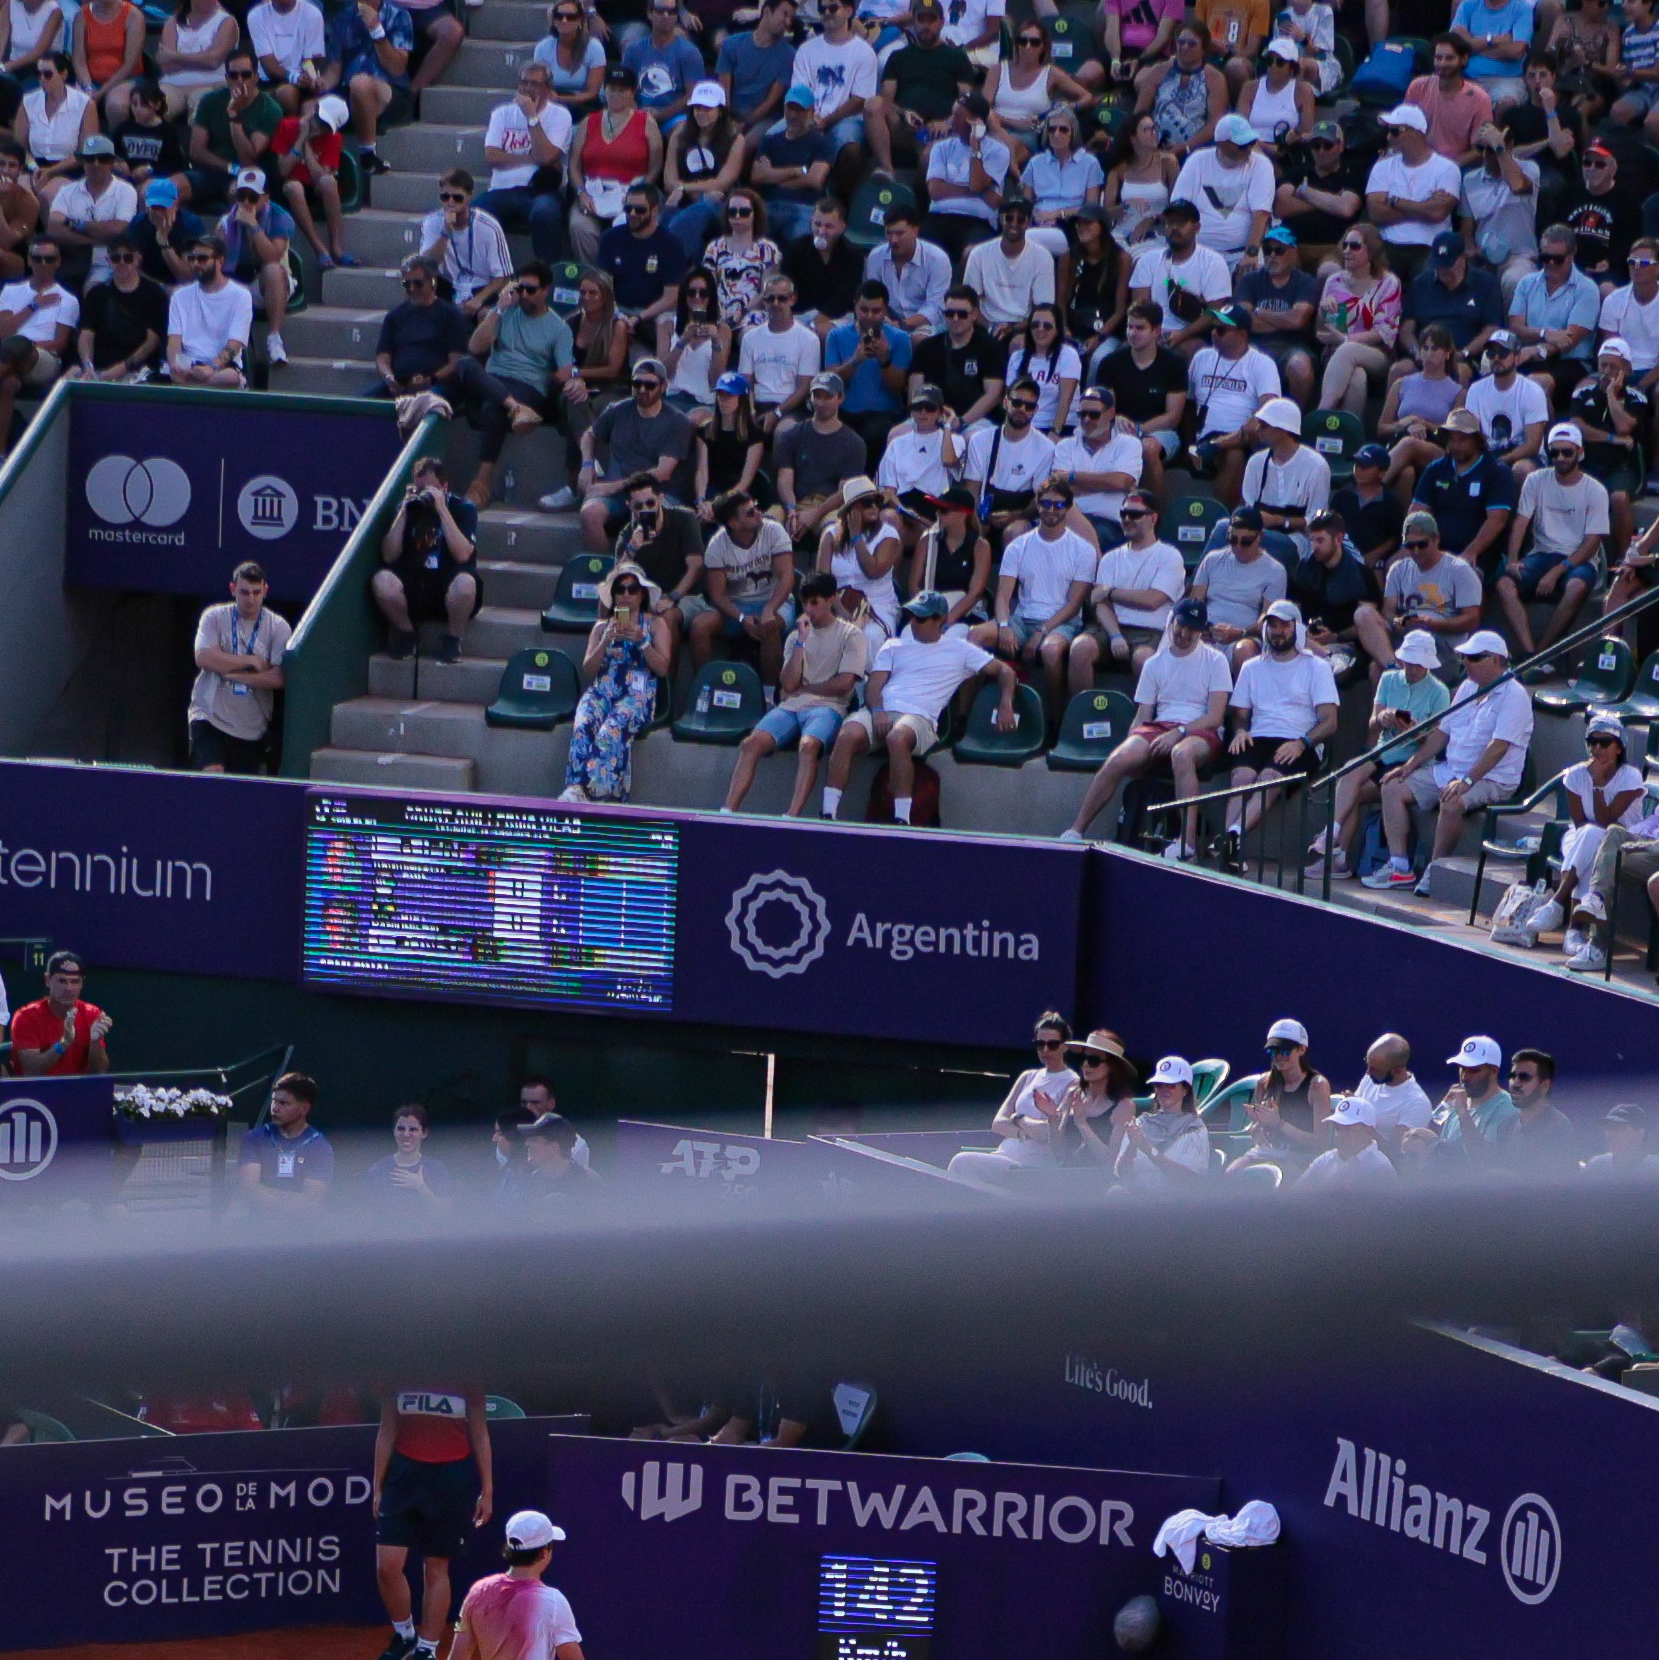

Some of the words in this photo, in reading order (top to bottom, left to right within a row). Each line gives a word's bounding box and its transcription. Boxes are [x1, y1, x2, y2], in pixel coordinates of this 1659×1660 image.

[313, 496, 368, 534] BN
[88, 528, 186, 547] mastercard
[846, 912, 1040, 961] Argentina
[659, 1138, 761, 1180] ATP
[402, 1393, 455, 1415] FILA
[1104, 1367, 1154, 1410] Good.
[44, 1482, 224, 1522] MUSEO
[235, 1497, 257, 1511] LA
[236, 1481, 258, 1497] DE
[269, 1475, 372, 1510] MOD
[1323, 1436, 1488, 1565] Allianz
[724, 1473, 1136, 1547] BETWARRIOR
[104, 1544, 182, 1574] THE
[197, 1535, 341, 1568] TENNIS
[103, 1568, 341, 1608] COLLECTION
[1164, 1574, 1222, 1614] BONVOY
